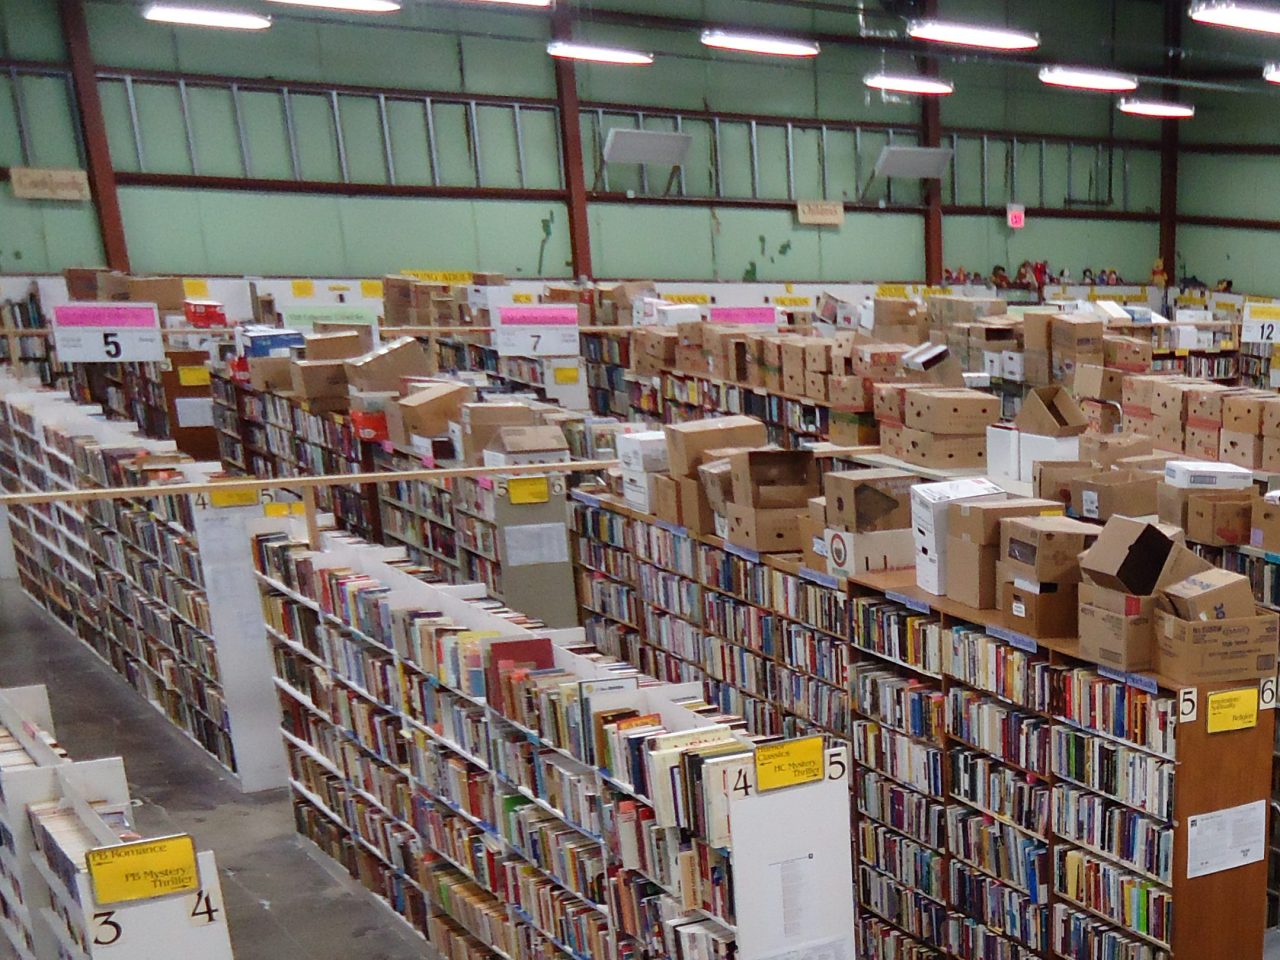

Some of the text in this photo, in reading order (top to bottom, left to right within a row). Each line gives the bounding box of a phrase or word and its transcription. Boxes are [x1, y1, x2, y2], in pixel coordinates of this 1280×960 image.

[530, 334, 542, 352] 7
[1260, 323, 1275, 341] 12
[103, 332, 122, 359] 5
[195, 492, 208, 509] 4
[1181, 690, 1195, 716] 5
[1261, 679, 1275, 704] 6
[828, 752, 846, 780] 5
[733, 768, 752, 796] 4
[91, 844, 167, 862] PB Romance
[124, 872, 141, 882] PB
[151, 876, 193, 889] Thriller
[192, 889, 219, 922] 4
[93, 910, 122, 945] 3
